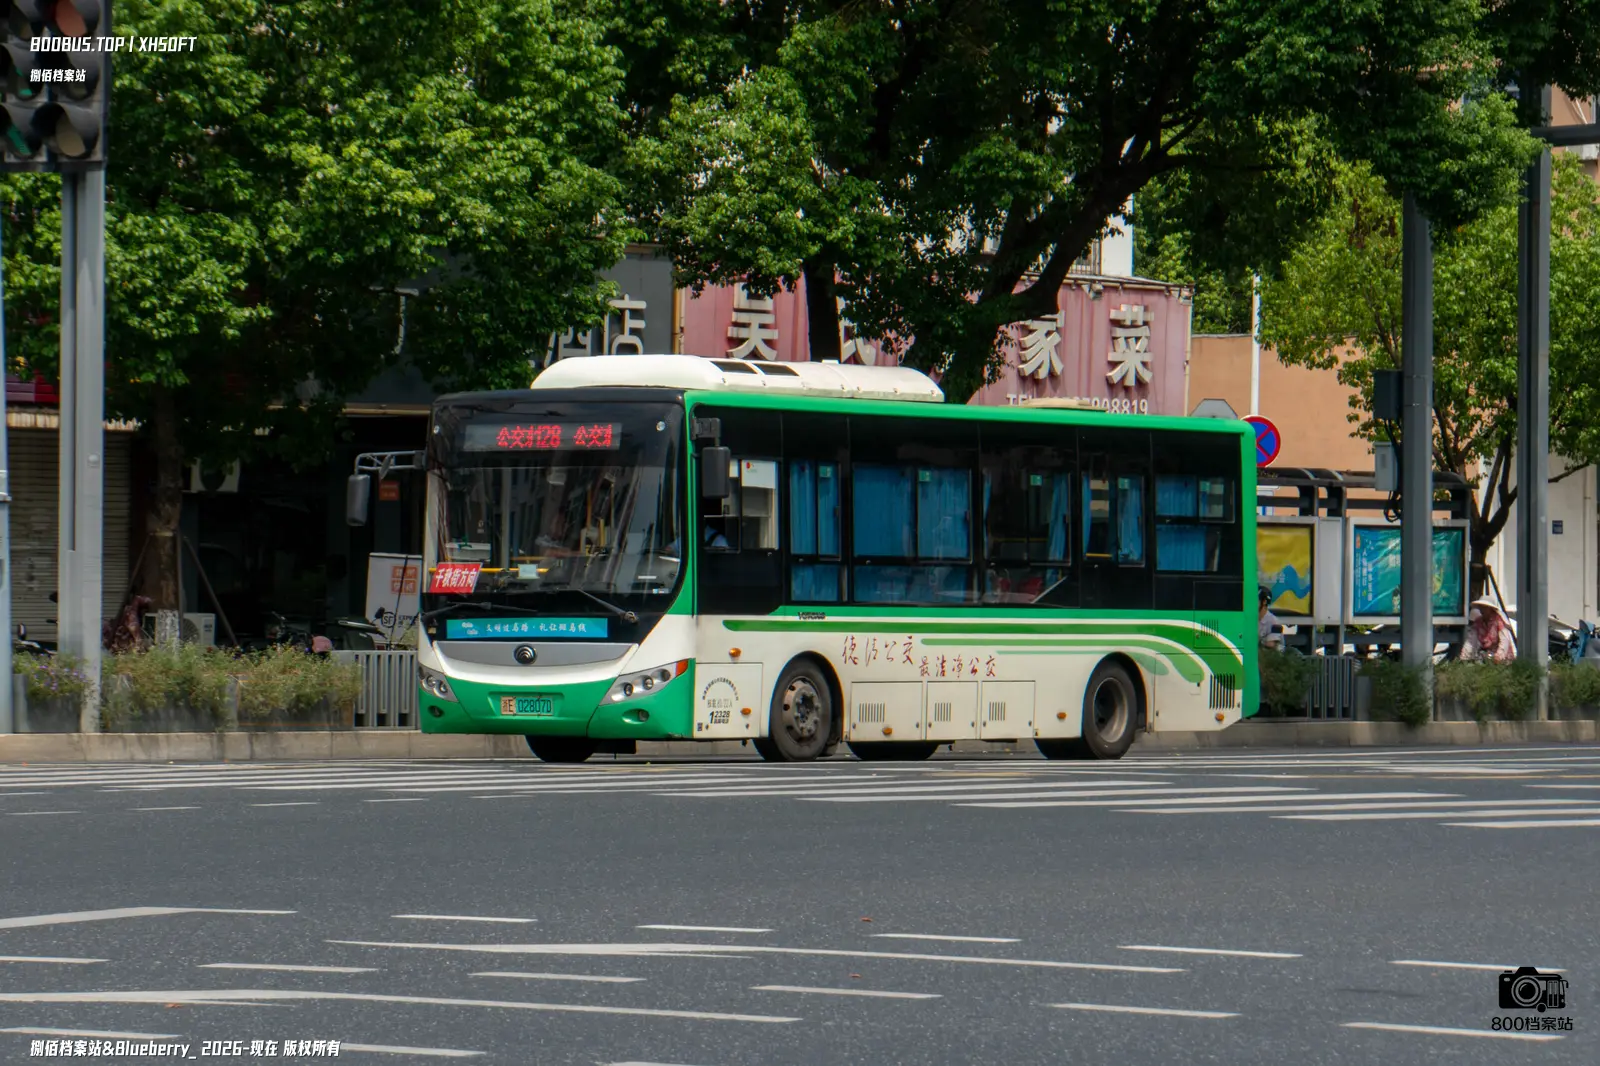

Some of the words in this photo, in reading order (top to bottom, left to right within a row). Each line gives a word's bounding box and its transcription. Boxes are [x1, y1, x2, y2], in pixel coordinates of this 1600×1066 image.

[435, 567, 478, 588] 千秋街方向
